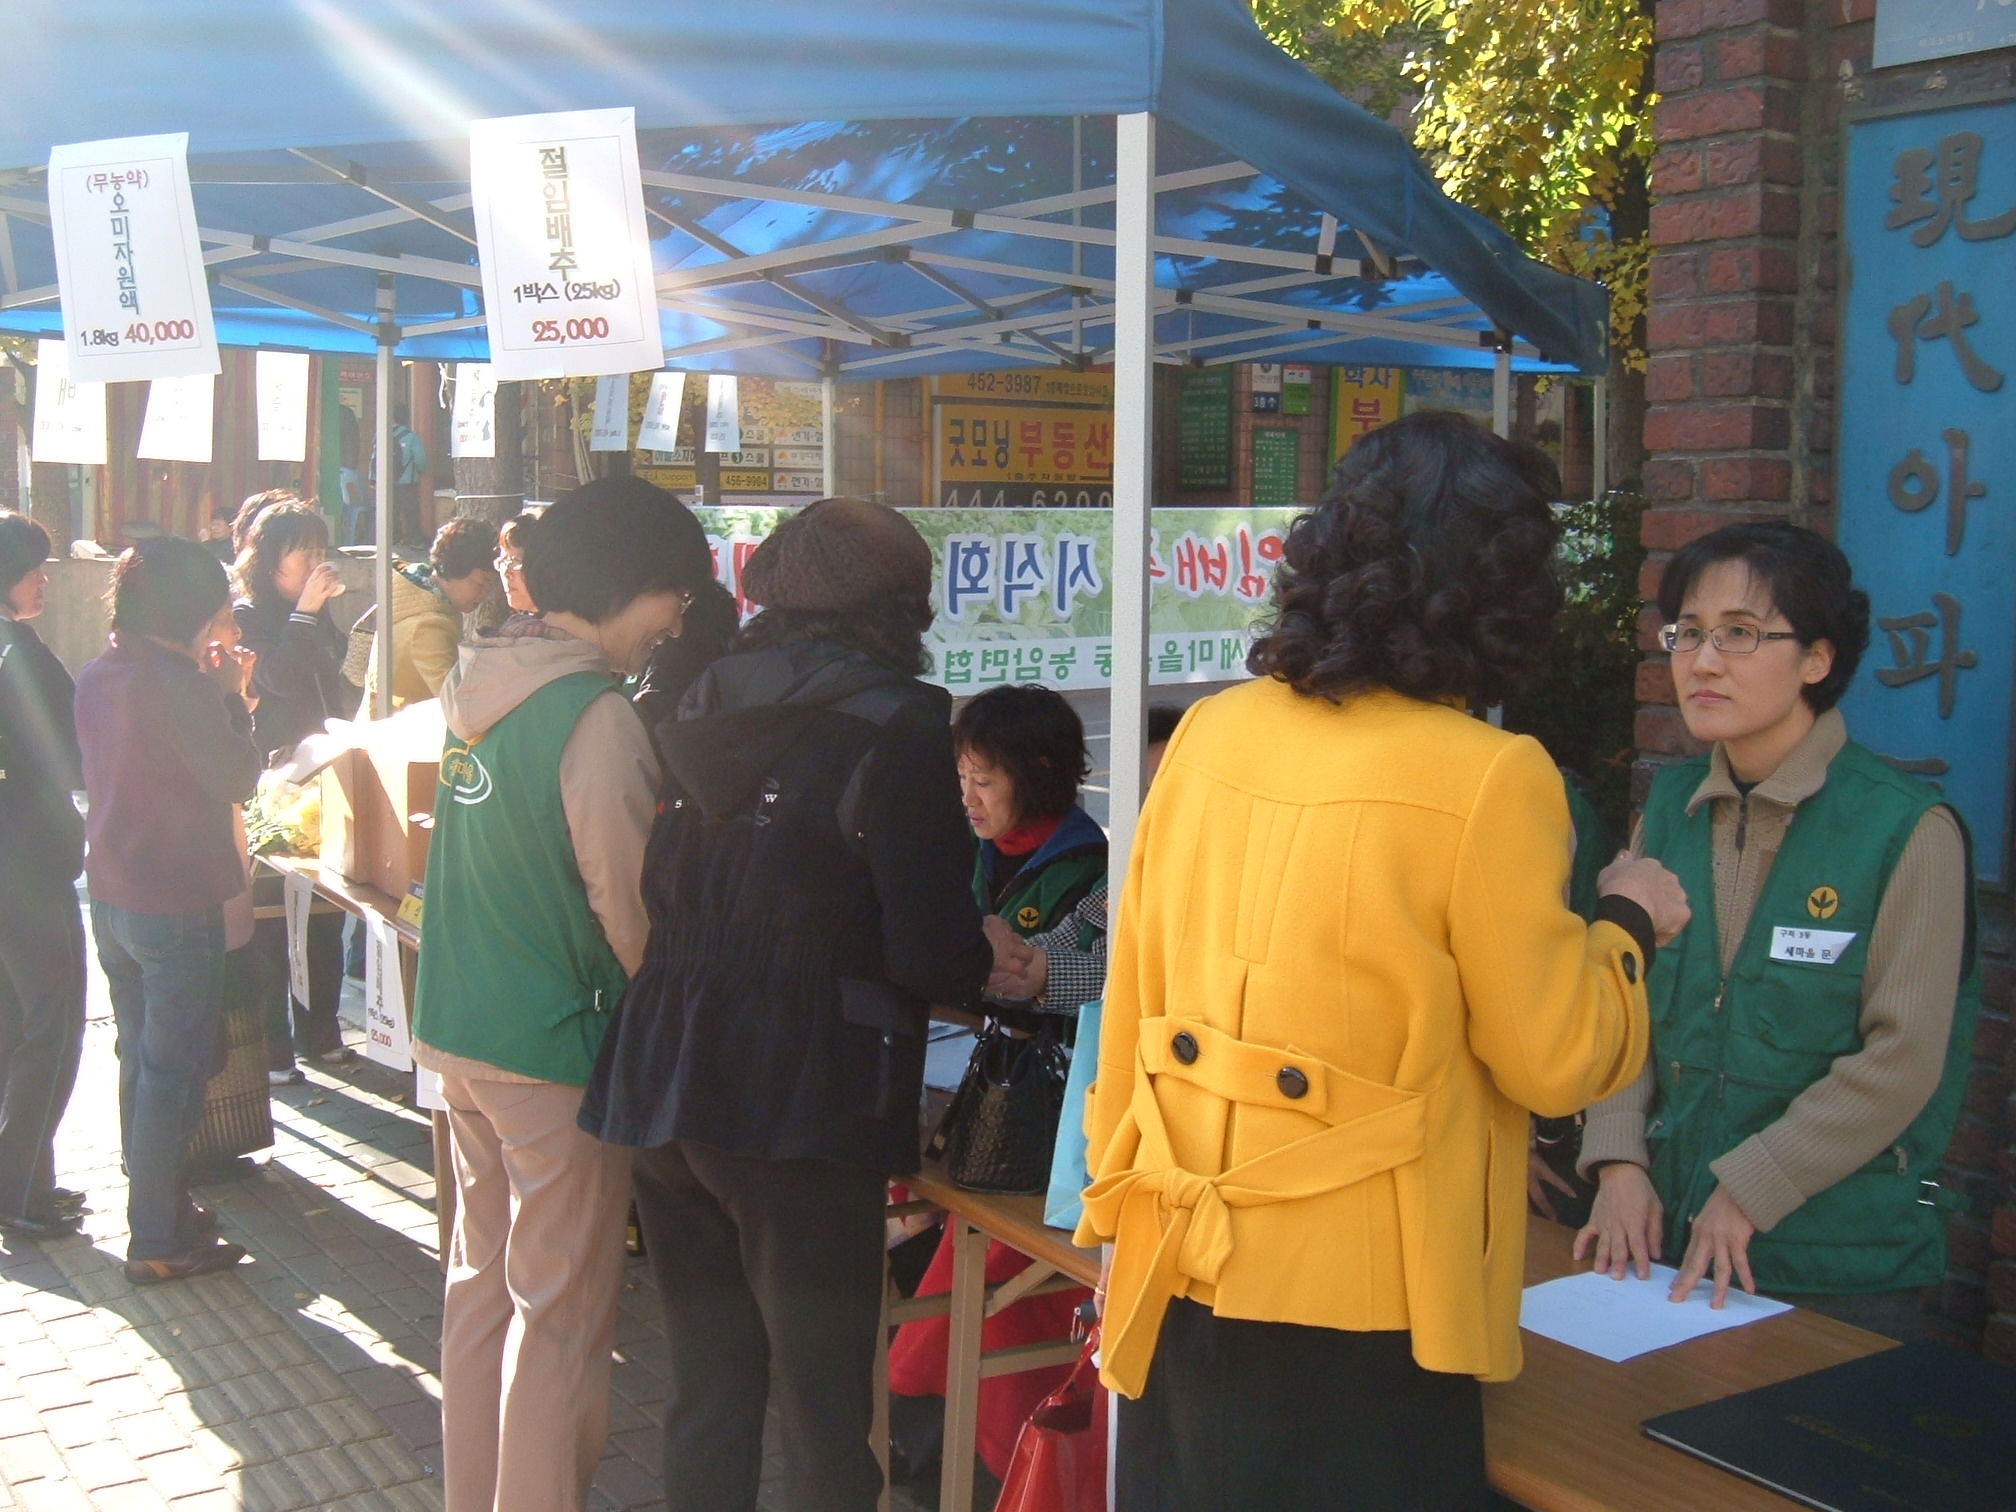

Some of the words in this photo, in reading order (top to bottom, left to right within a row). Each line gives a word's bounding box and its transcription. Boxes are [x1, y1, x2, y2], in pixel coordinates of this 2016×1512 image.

[86, 169, 149, 193] (무농약)
[538, 146, 578, 281] 절임배추
[110, 192, 140, 315] 오미자원액
[514, 282, 560, 303] 1박스
[565, 279, 621, 302] (25kg)
[80, 329, 119, 347] 1.8kg
[124, 319, 194, 345] 40,000
[532, 316, 609, 344] 25,000
[967, 373, 1041, 394] 452-3987
[1019, 421, 1110, 470] 부동산
[1785, 946, 1815, 959] 새마을
